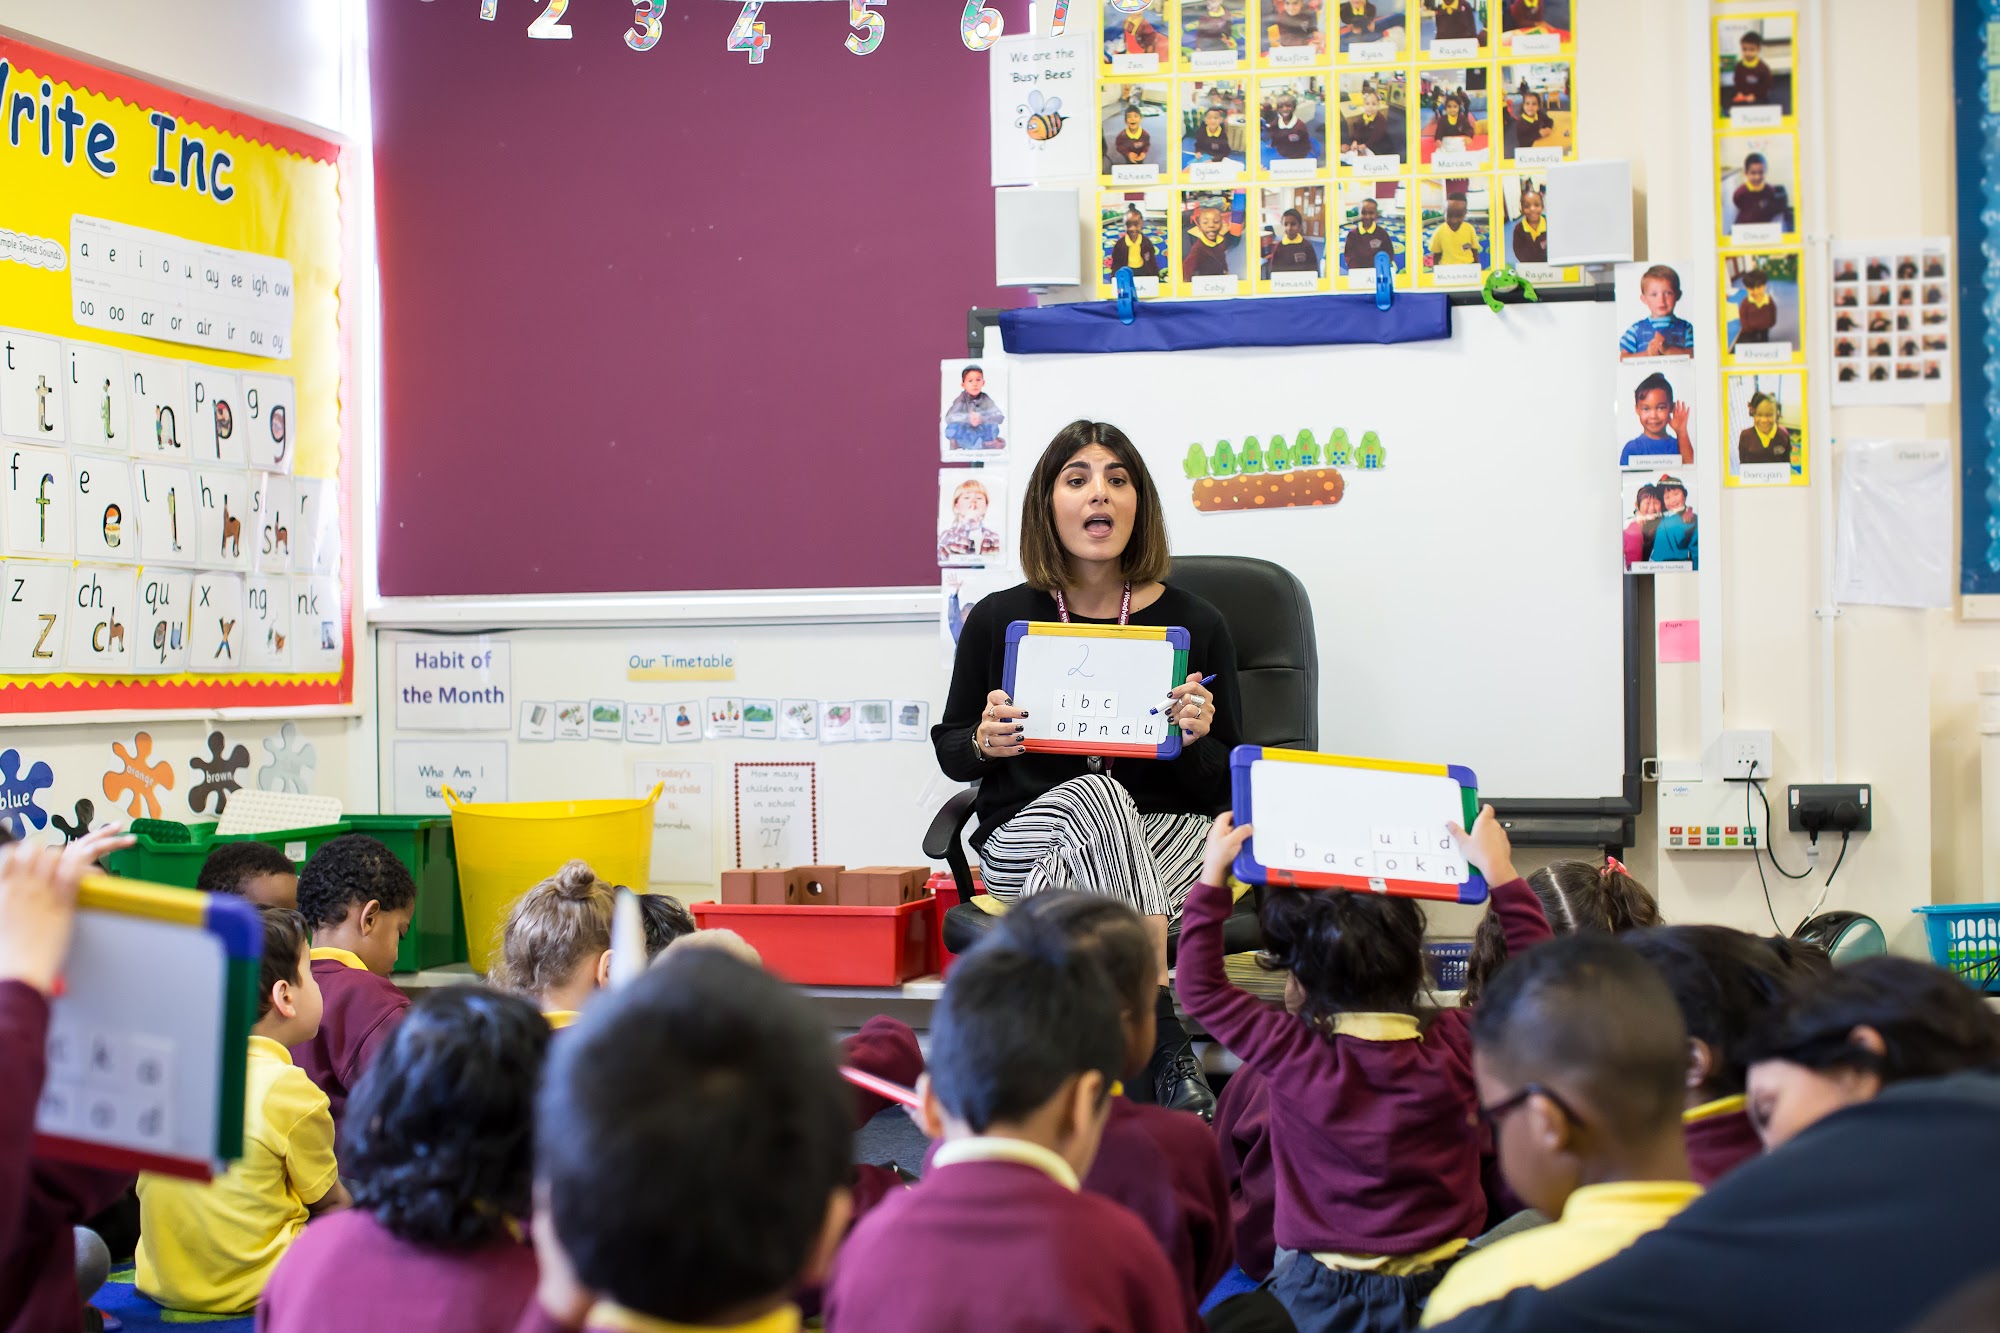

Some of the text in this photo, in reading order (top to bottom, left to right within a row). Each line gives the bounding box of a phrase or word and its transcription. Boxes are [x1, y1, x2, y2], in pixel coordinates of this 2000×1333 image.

[624, 0, 667, 52] 3
[727, 0, 771, 64] 4
[844, 0, 887, 55] 5
[961, 0, 1004, 51] 6
[1010, 48, 1074, 62] We are the
[0, 59, 235, 202] rite Inc
[19, 240, 38, 258] Speed
[39, 247, 62, 262] Sounds
[81, 243, 89, 258] a
[109, 248, 116, 262] e
[163, 260, 170, 273] o
[184, 265, 192, 279] u
[206, 269, 219, 289] ay
[231, 274, 243, 288] ee
[252, 274, 269, 297] igh
[274, 282, 290, 297] ow
[141, 311, 155, 325] ar
[170, 316, 182, 330] or
[196, 317, 212, 335] air
[250, 330, 263, 345] ou
[6, 340, 15, 370] t
[133, 371, 146, 396] n
[194, 381, 205, 413] p
[247, 388, 259, 419] g
[11, 452, 20, 491] f
[80, 470, 90, 494] e
[200, 475, 214, 509] h
[78, 572, 103, 609] ch
[145, 581, 170, 616] qu
[199, 585, 211, 608] x
[249, 588, 267, 620] ng
[297, 585, 319, 616] nk
[1120, 591, 1131, 626] Woodview
[415, 650, 492, 669] Habit of
[629, 654, 733, 669] Our Timetable
[1067, 644, 1094, 677] 2
[403, 684, 505, 704] the Month
[1061, 694, 1112, 709] i b c
[1057, 722, 1153, 737] o p n a u
[126, 765, 154, 789] orange
[206, 770, 232, 784] brown
[418, 764, 444, 778] Who
[453, 764, 472, 778] Am
[656, 768, 691, 780] Today's
[751, 769, 799, 781] How many
[426, 785, 477, 803] Becing?
[679, 784, 701, 794] child
[746, 784, 803, 793] children are
[0, 789, 30, 811] blue
[753, 799, 796, 808] in school
[760, 815, 791, 827] today?
[760, 827, 782, 849] 27
[1379, 833, 1391, 844] u
[1439, 835, 1450, 850] d
[1294, 843, 1457, 877] b a c o k n
